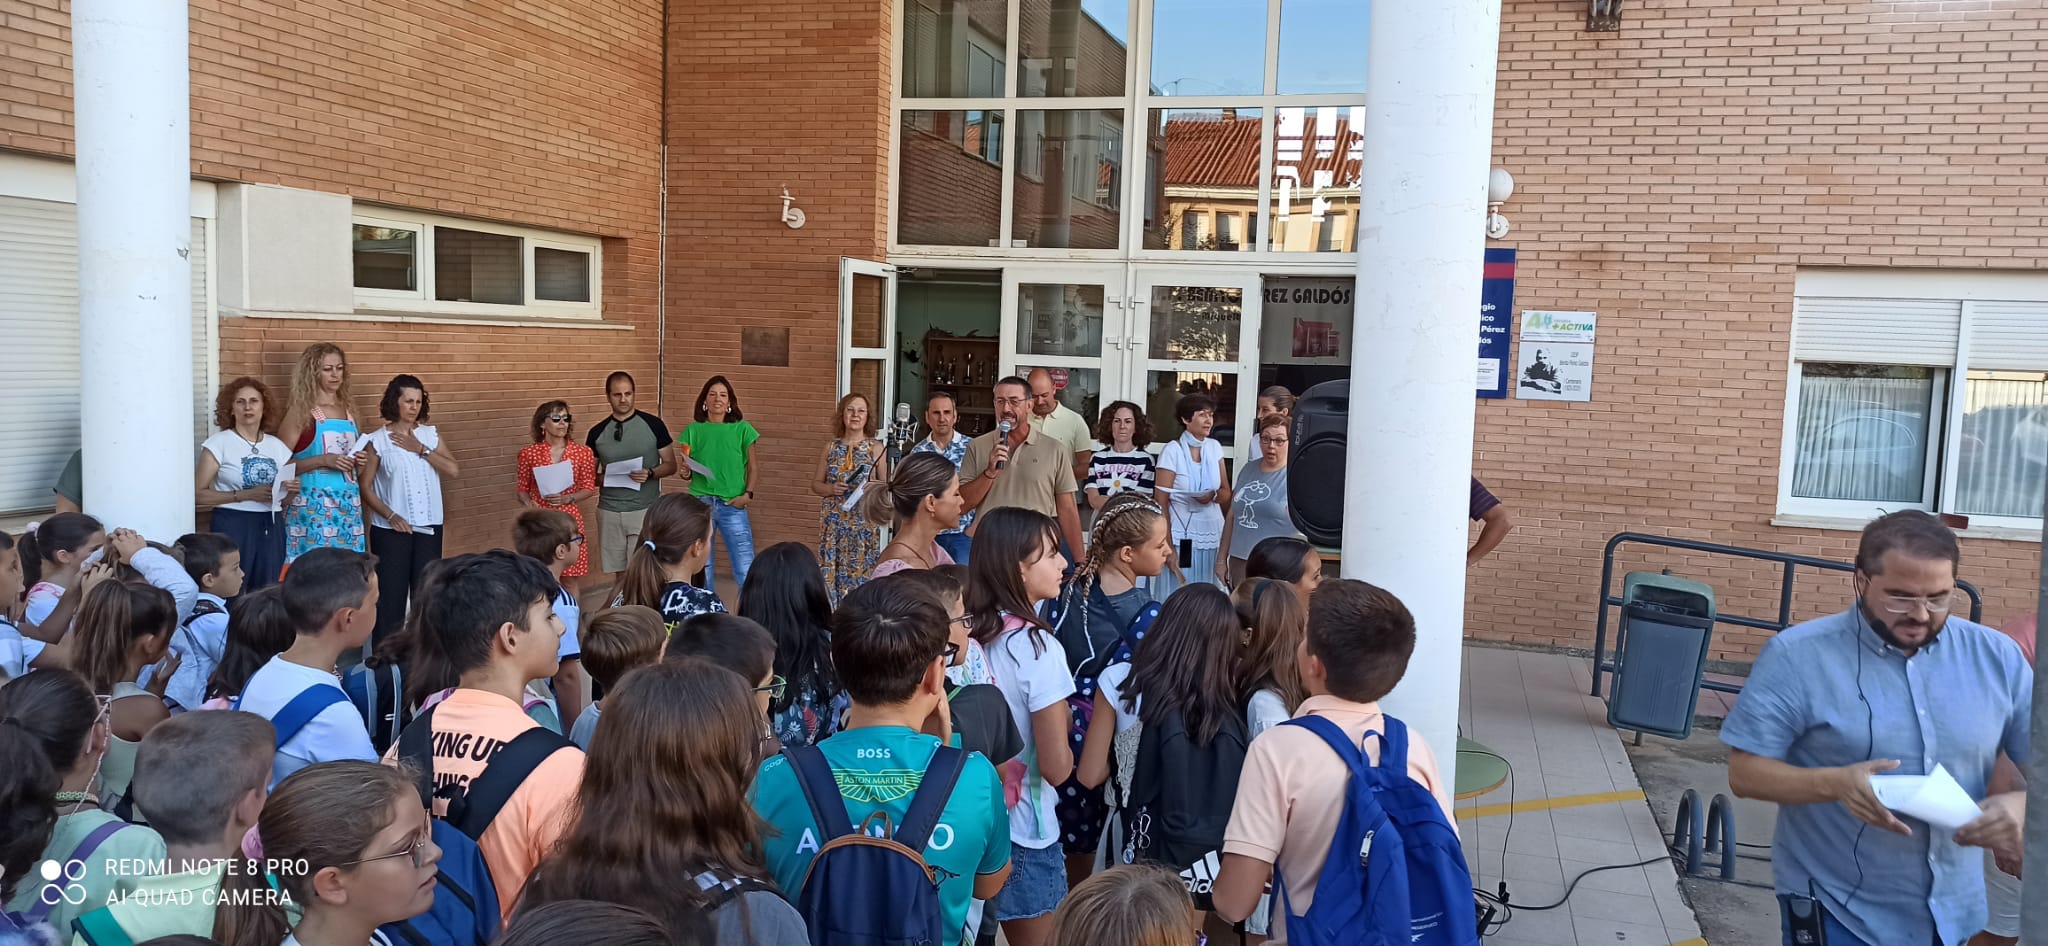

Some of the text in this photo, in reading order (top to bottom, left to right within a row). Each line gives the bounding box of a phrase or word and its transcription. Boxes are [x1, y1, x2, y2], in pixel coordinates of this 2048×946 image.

[1264, 288, 1288, 304] REZ
[1292, 286, 1351, 304] GALDÓS
[857, 748, 891, 759] BOSS
[844, 776, 904, 785] ASTON MARTIN
